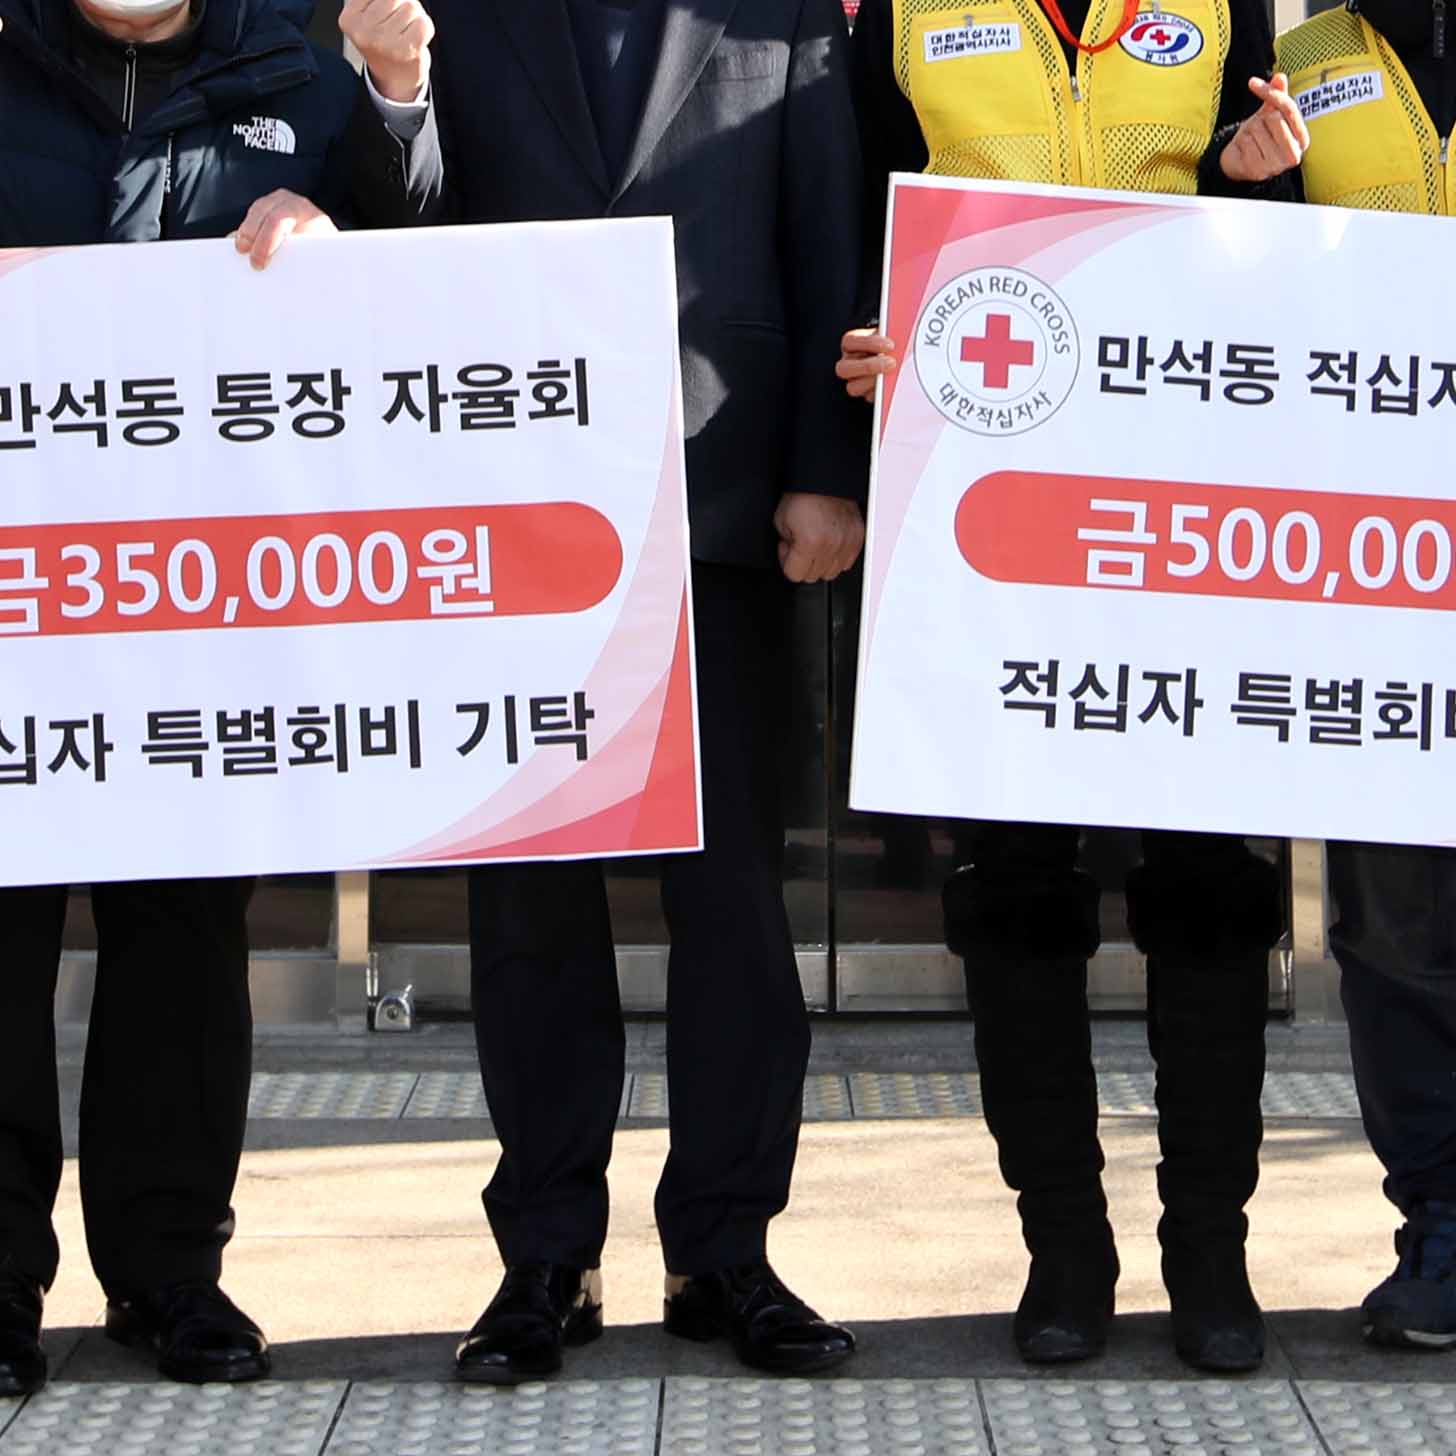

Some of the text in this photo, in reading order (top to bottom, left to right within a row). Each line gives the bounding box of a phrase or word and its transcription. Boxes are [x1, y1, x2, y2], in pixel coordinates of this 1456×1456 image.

[233, 124, 276, 140] NORTH
[244, 134, 276, 151] FACE
[252, 116, 276, 130] THE
[925, 276, 1071, 355] KOREAN RED CROSS
[211, 369, 352, 442] 통장
[382, 359, 589, 432] 자율회
[938, 382, 1053, 428] 대한적십자사
[1097, 335, 1280, 405] 만석동
[999, 659, 1204, 737] 적십자
[141, 699, 422, 778] 특별회비
[455, 691, 595, 764] 기탁
